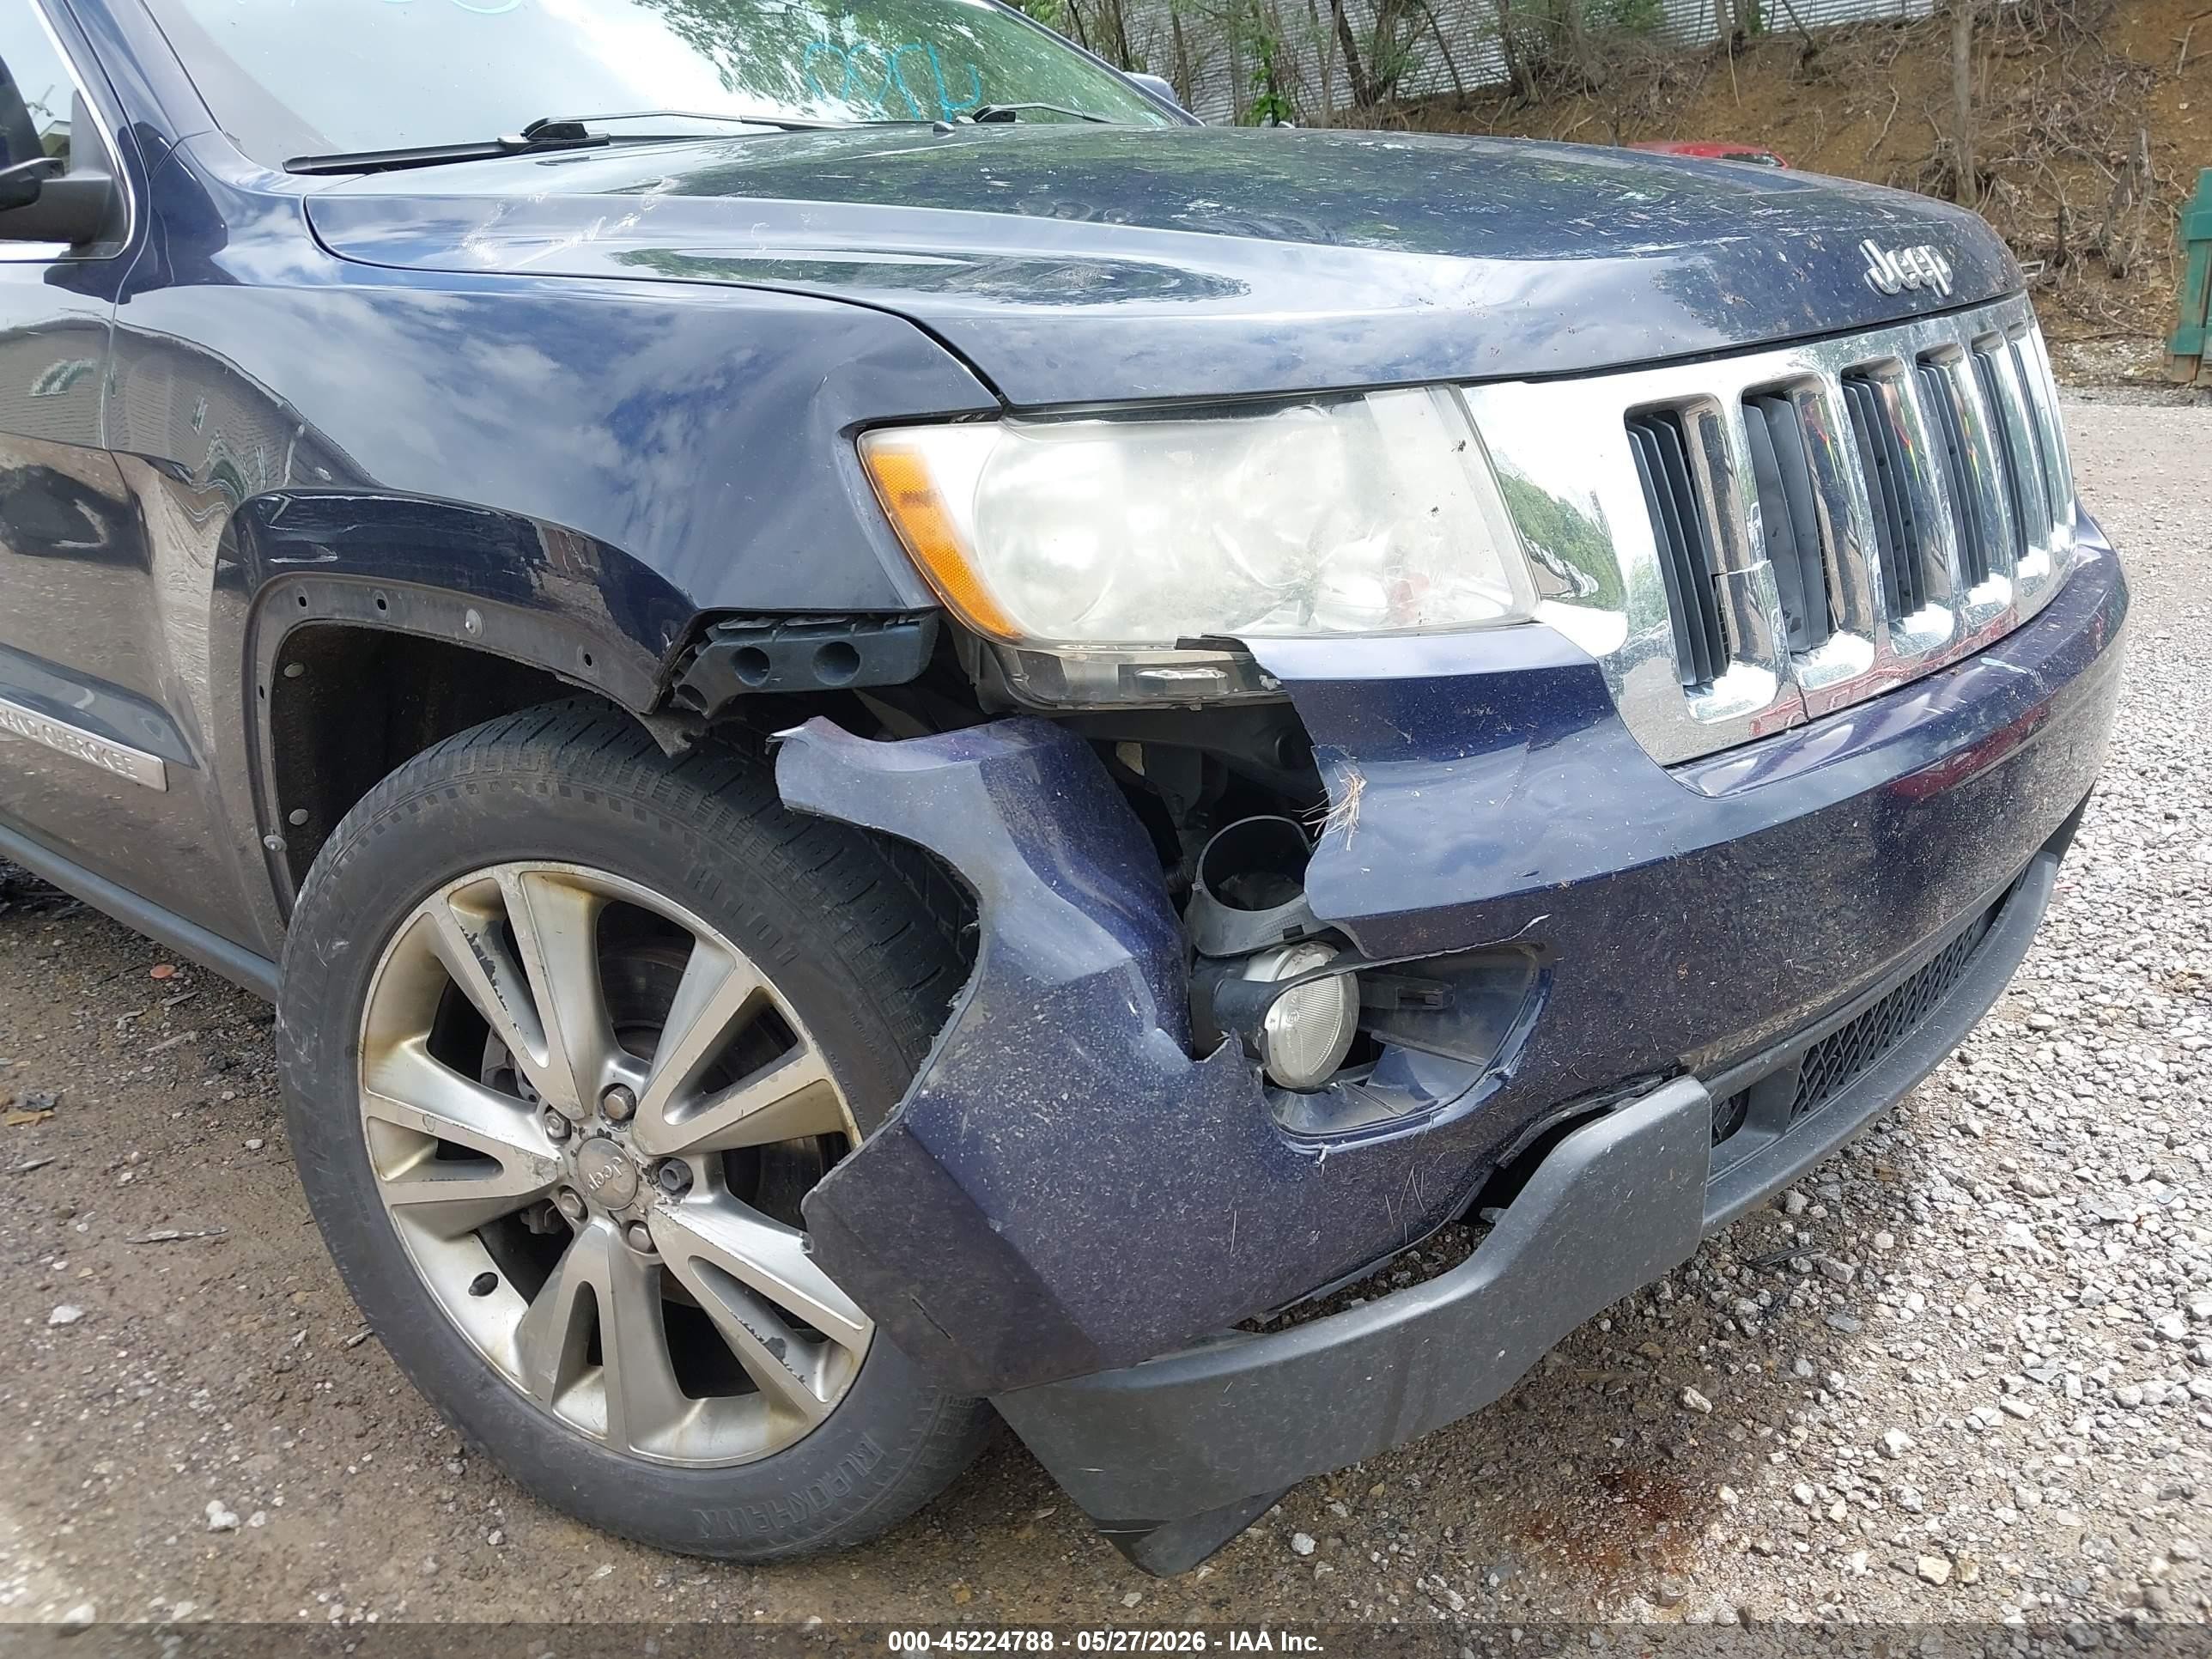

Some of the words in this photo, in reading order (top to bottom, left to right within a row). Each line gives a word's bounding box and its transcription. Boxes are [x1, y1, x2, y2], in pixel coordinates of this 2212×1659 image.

[1859, 239, 1953, 296] Jeep
[42, 723, 139, 779] CHEROKEE
[587, 1156, 623, 1190] Jeep
